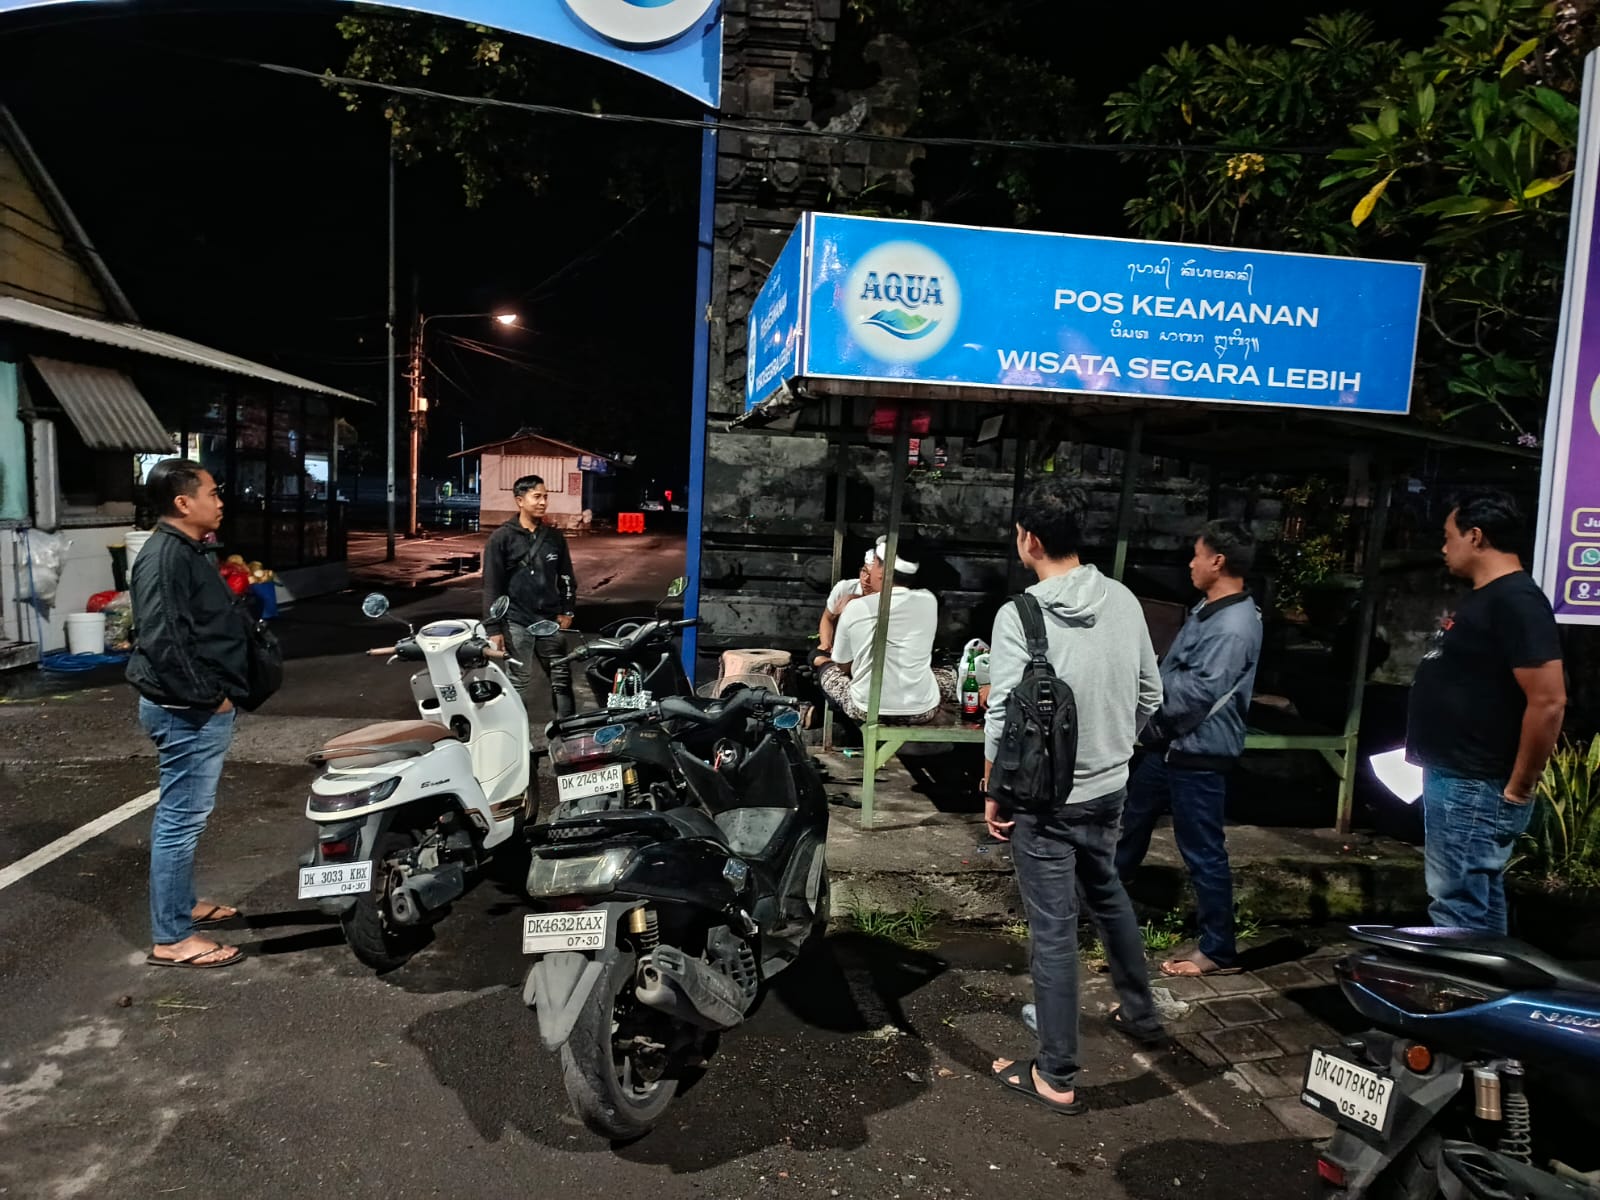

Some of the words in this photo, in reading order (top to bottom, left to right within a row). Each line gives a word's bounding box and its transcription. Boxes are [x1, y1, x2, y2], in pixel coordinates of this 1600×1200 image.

[859, 271, 944, 310] AQUA
[1053, 287, 1124, 315] POS
[1131, 293, 1320, 329] KEAMANAN
[997, 348, 1123, 380] WISATA
[1127, 358, 1261, 387] SEGARA
[1266, 365, 1362, 393] LEBIH
[560, 776, 574, 791] DK
[576, 772, 598, 787] 2748
[600, 768, 619, 782] KAR
[303, 873, 315, 886] DK
[321, 870, 343, 883] 3033
[350, 867, 368, 880] KBX
